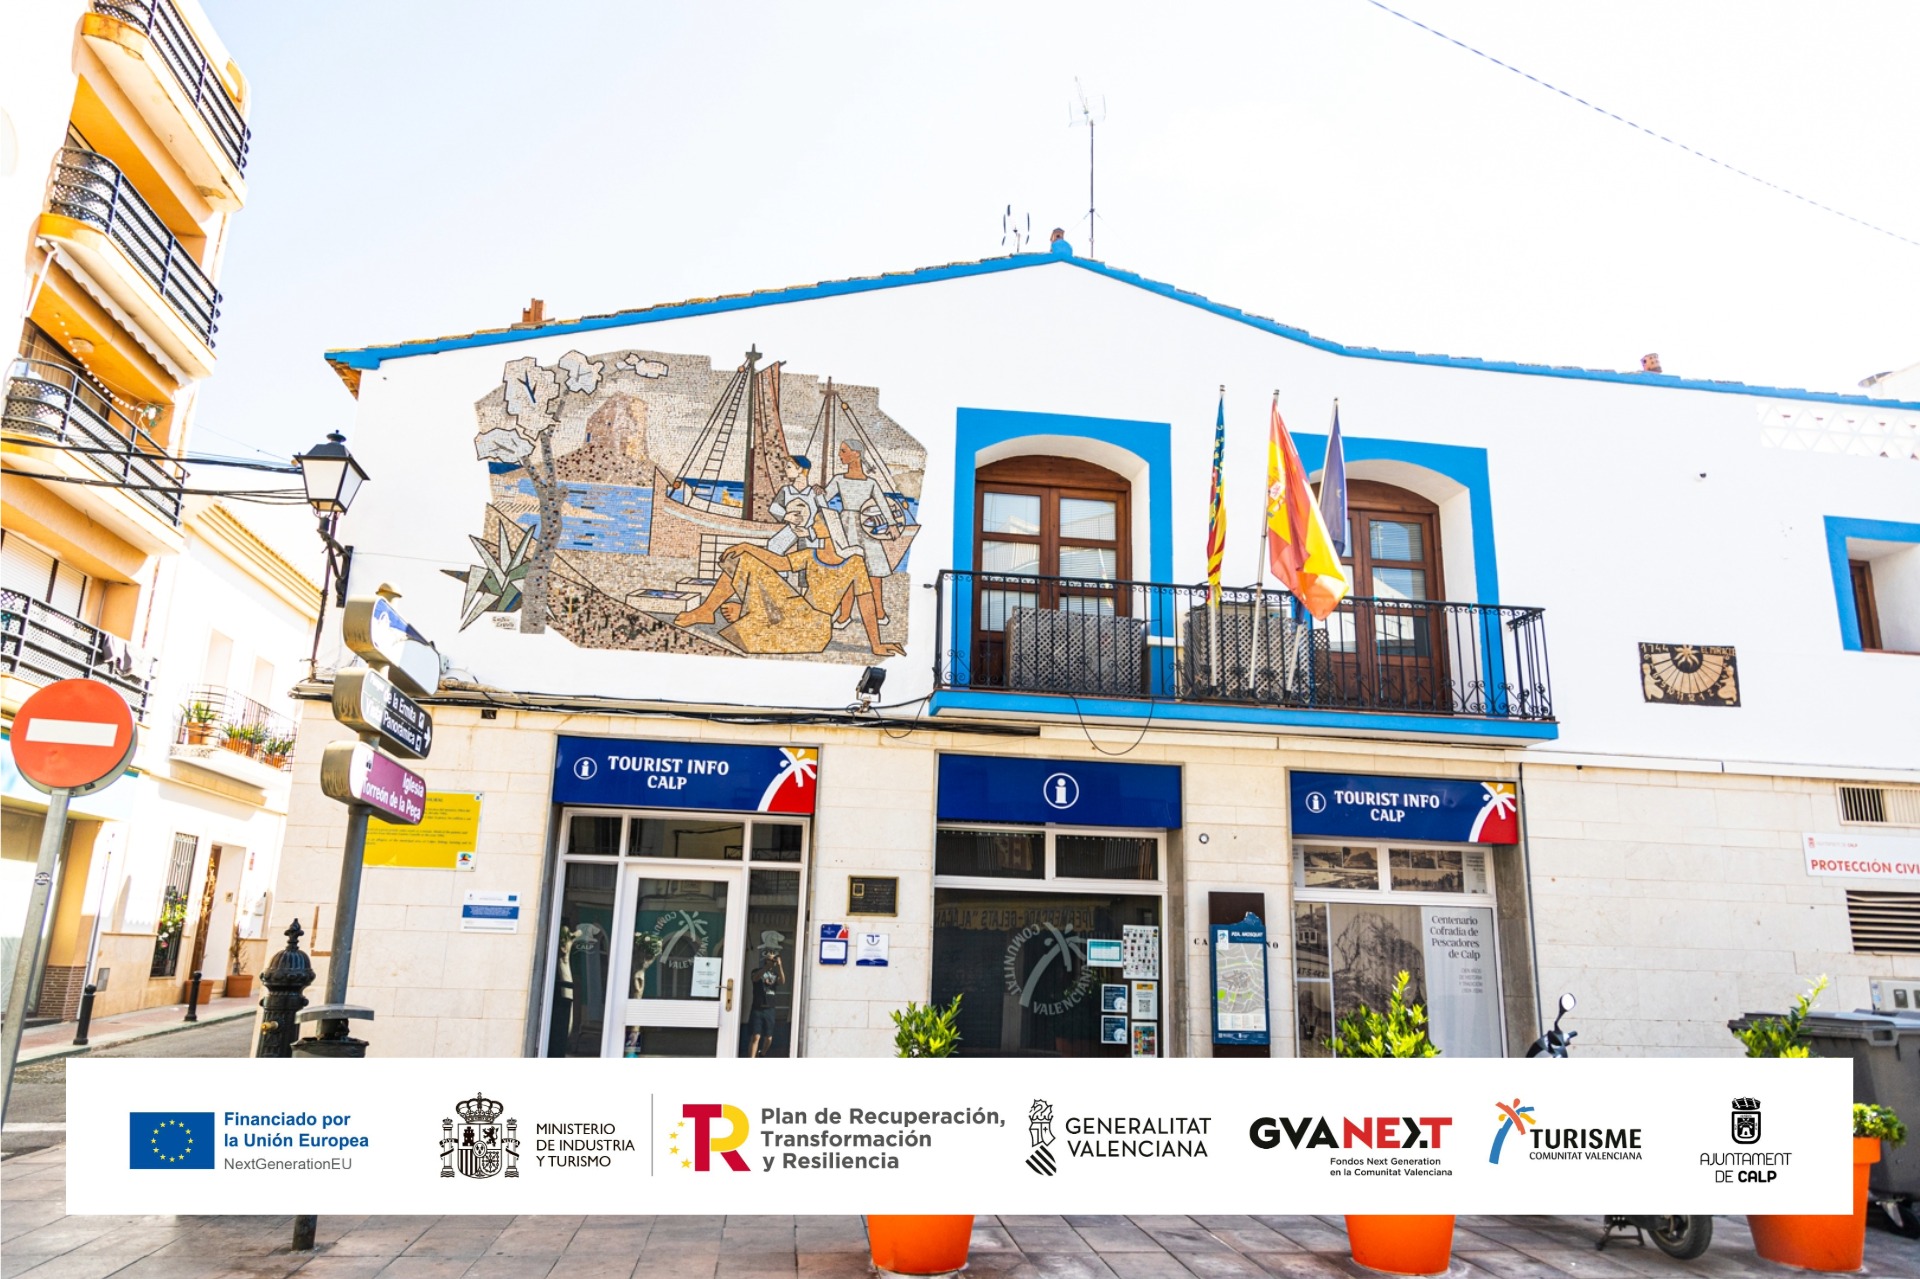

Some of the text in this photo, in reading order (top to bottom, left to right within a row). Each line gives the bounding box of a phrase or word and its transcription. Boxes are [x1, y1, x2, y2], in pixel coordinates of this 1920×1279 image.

[1641, 643, 1669, 653] 1744
[392, 692, 399, 710] la
[398, 696, 417, 724] Ermita
[607, 755, 730, 776] TOURIST INFO
[402, 772, 425, 798] Iglesia
[647, 775, 688, 790] CALP
[361, 776, 389, 805] Torreón
[389, 791, 399, 809] de
[398, 795, 405, 813] la
[1333, 790, 1440, 809] TOURIST INFO
[1370, 808, 1406, 823] CALP
[1810, 858, 1893, 874] PROTECCIÓN
[1431, 915, 1478, 925] Centenario
[1467, 927, 1479, 937] de
[1431, 938, 1480, 948] Pescadores
[1003, 923, 1041, 996] COMUNITAT
[1448, 949, 1481, 962] de Calp
[1033, 964, 1094, 1016] VALENCIANA
